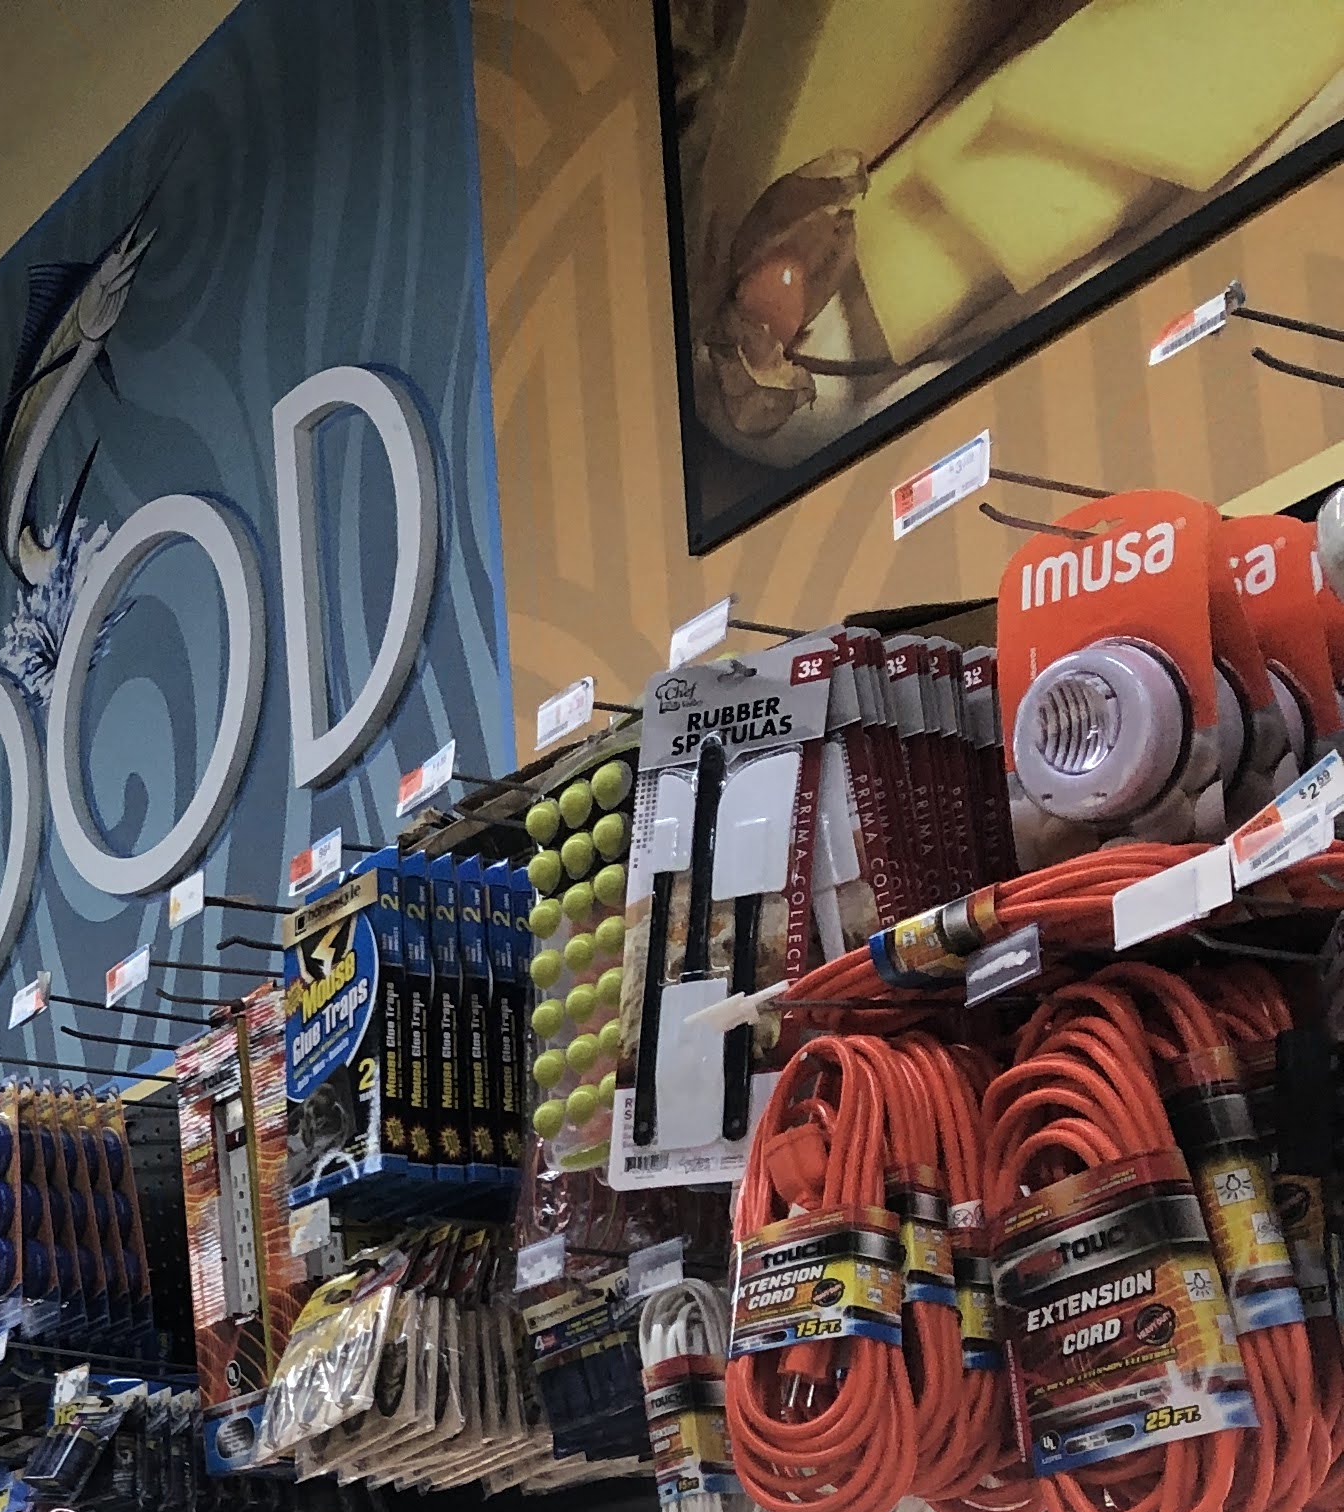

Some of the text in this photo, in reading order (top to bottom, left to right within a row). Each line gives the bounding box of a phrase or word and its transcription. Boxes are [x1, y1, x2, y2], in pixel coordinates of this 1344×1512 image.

[687, 697, 780, 732] RUBBER
[671, 715, 793, 756] SPTULAS
[794, 792, 814, 860] PRIMA
[855, 774, 879, 844] PRIMA
[293, 1022, 321, 1066] Glue
[322, 978, 368, 1028] Traps
[358, 1058, 376, 1091] 2
[749, 1287, 794, 1310] CORD
[1027, 1269, 1152, 1332] EXTENSION
[1063, 1319, 1121, 1355] CORD
